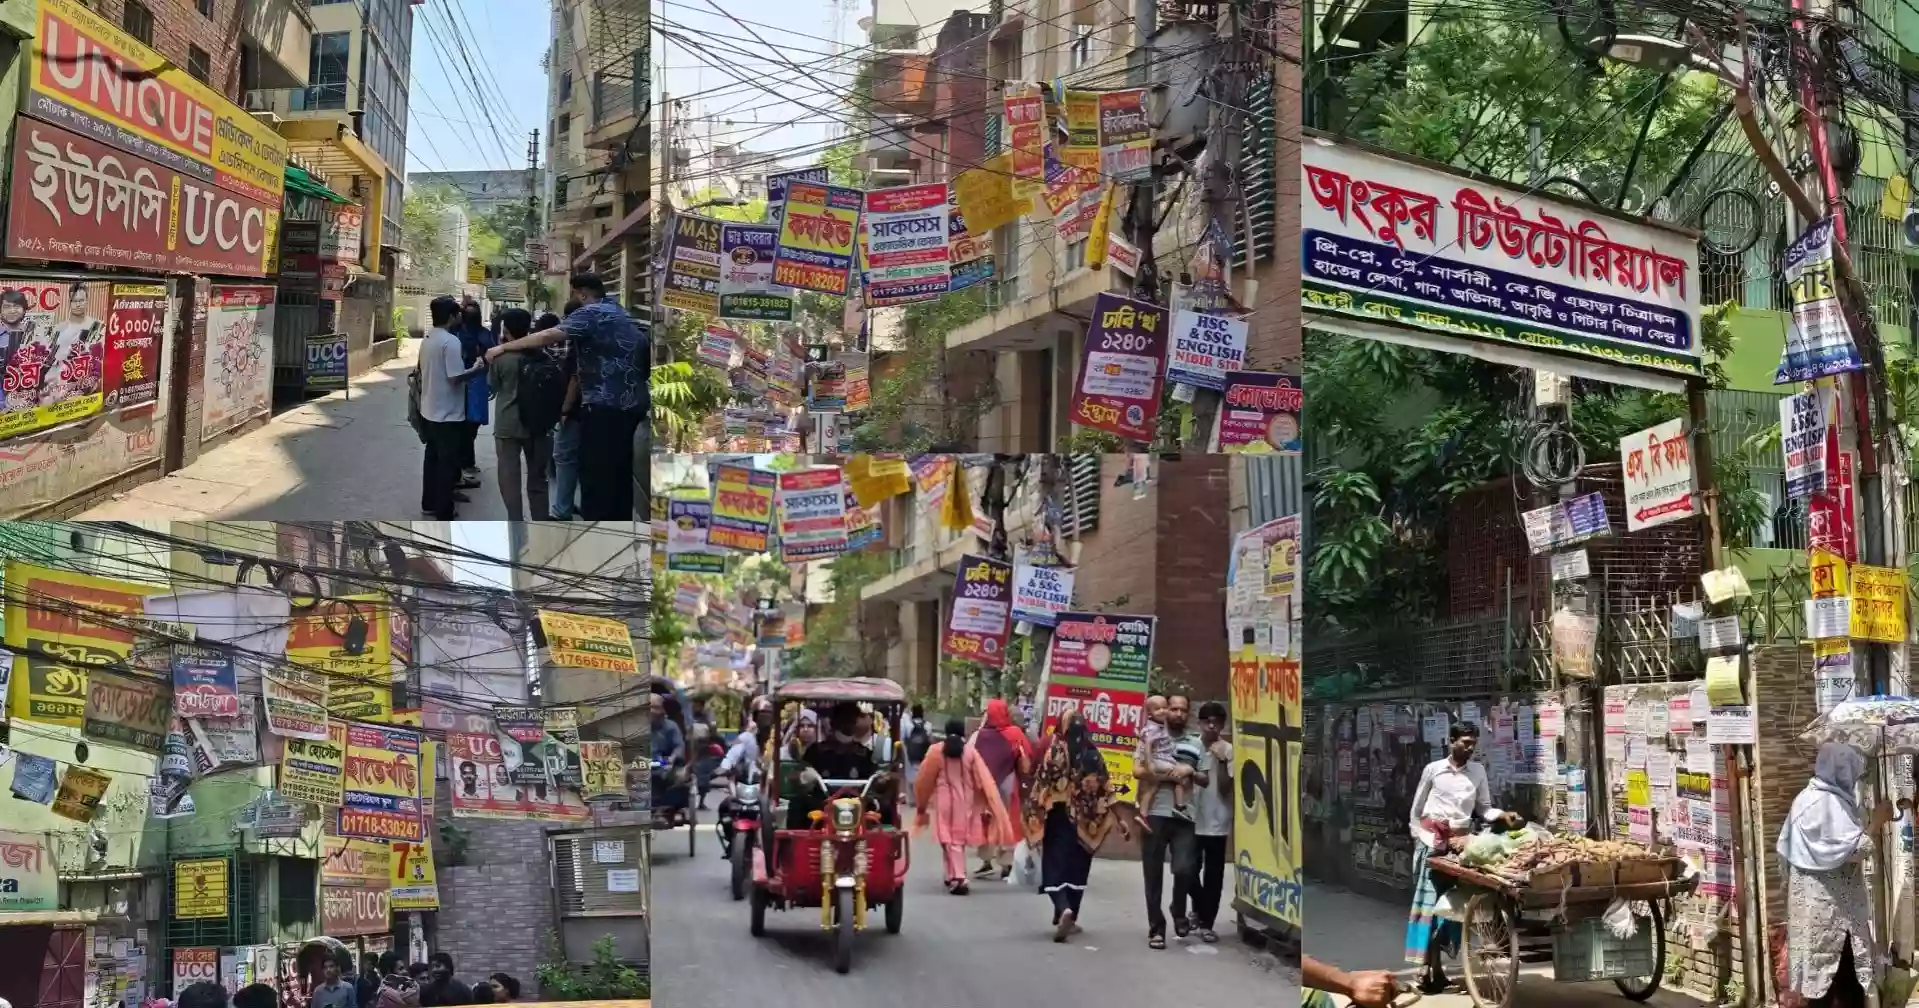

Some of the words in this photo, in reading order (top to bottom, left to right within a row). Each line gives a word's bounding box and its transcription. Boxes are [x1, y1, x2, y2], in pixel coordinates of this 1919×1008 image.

[47, 18, 213, 155] UNIQUE
[25, 130, 168, 238] ইউসিসি
[184, 183, 263, 254] UCC
[1302, 164, 1444, 257] অংকুর
[872, 216, 941, 238] সাকসেস
[1313, 257, 1361, 281] হাতের
[1366, 271, 1408, 292] লেখা,
[1414, 280, 1446, 301] গান,
[1450, 287, 1507, 312] অভিনয়,
[1556, 311, 1568, 322] ও
[1571, 312, 1608, 331] গিটার
[1611, 318, 1643, 338] শিক্ষা
[1647, 328, 1677, 345] কেন্দ্র
[1563, 294, 1615, 315] এছাড়া
[1102, 305, 1137, 330] ঢাবি
[1196, 315, 1229, 332] HSC
[1189, 327, 1200, 340] &
[1202, 329, 1233, 346] SSC
[308, 343, 346, 361] UCC
[1175, 338, 1243, 361] ENGLISH
[1792, 394, 1816, 410] HSC
[1799, 410, 1819, 430] SSC
[1785, 427, 1826, 454] ENGLISH
[1648, 433, 1662, 477] বি
[785, 492, 838, 509] সাকসেস
[1034, 568, 1060, 582] HSC
[1038, 579, 1062, 592] SSC
[1018, 586, 1069, 605] ENGLISH
[574, 639, 631, 655] Fingers
[347, 752, 416, 796] হাতেখড়ি
[342, 815, 420, 839] 01718-530247
[356, 891, 386, 920] UCC
[175, 962, 215, 977] UCC
